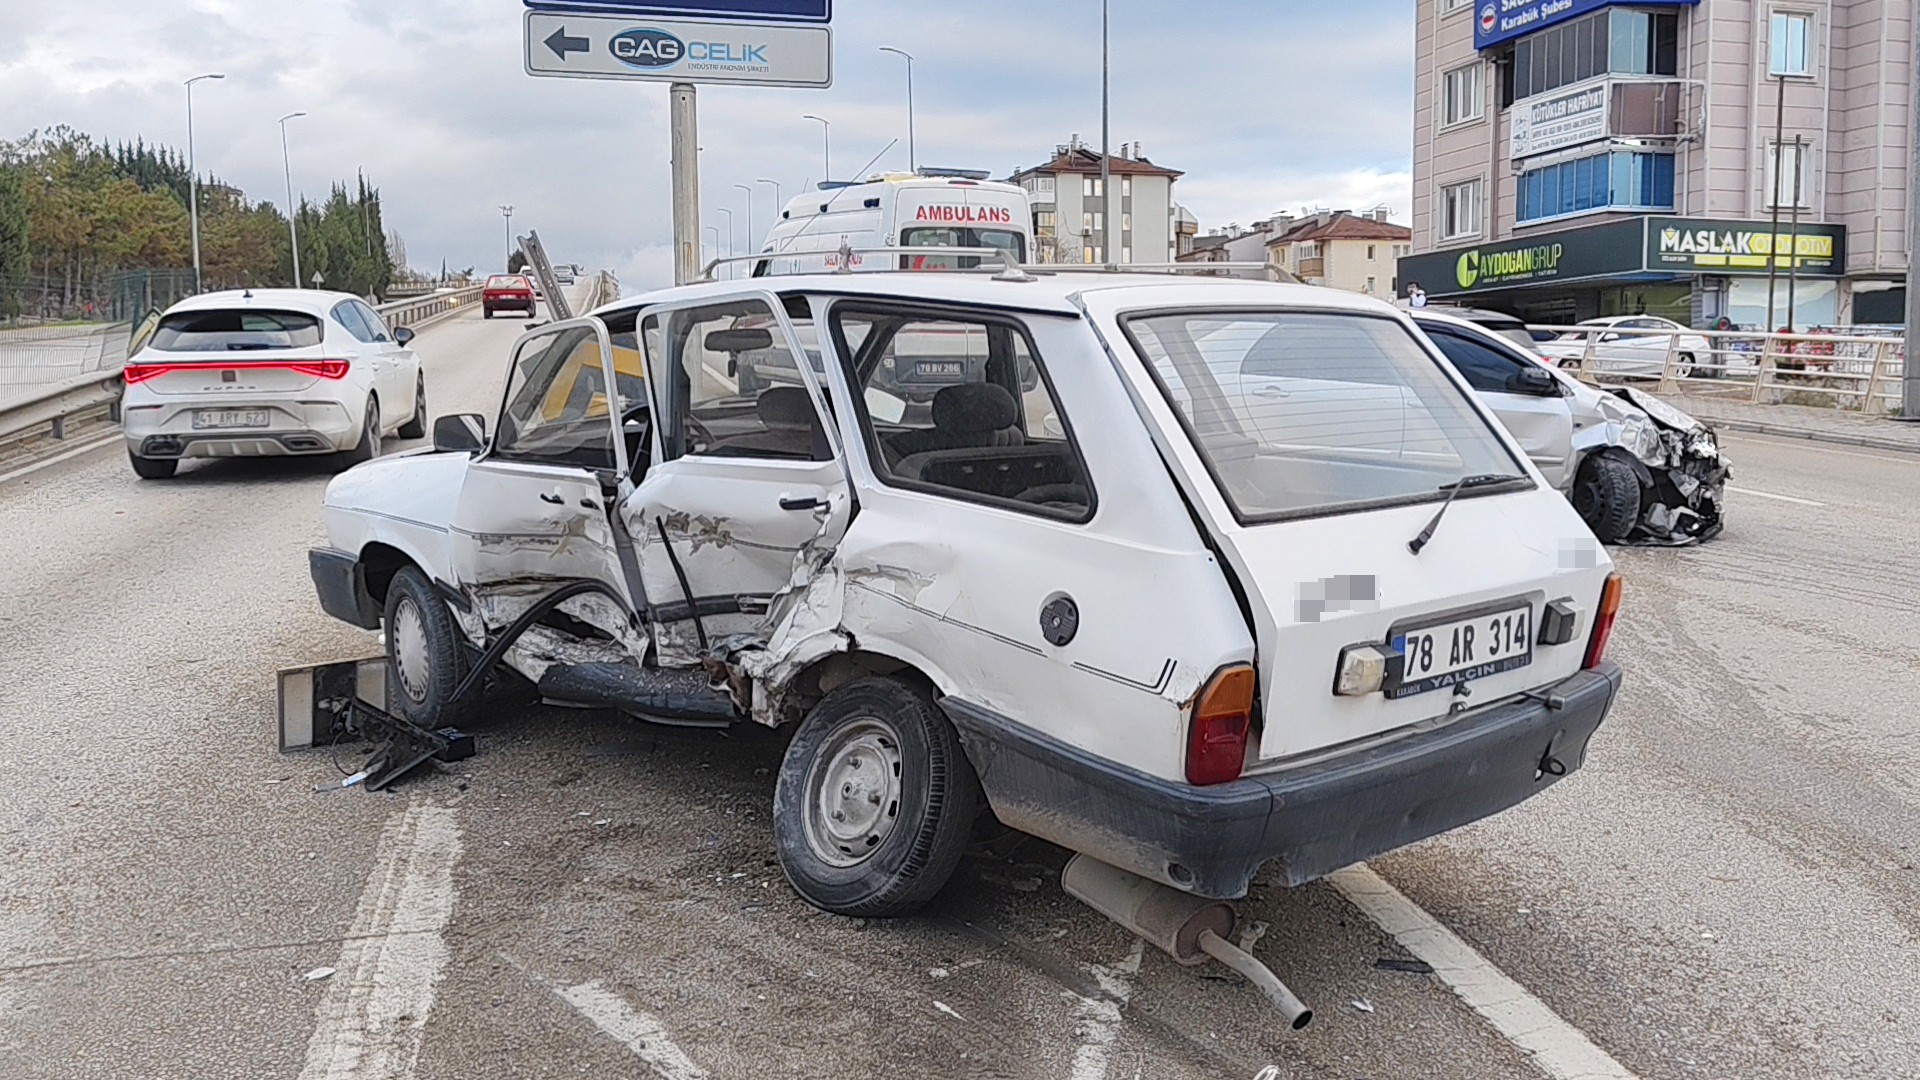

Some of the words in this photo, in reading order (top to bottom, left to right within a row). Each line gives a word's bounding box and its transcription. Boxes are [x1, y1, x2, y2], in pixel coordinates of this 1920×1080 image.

[1501, 7, 1539, 31] Karabük
[915, 205, 1011, 222] AMBULANS
[1660, 228, 1751, 253] MASLAK
[200, 413, 212, 424] 41
[219, 412, 239, 424] ARY
[1406, 633, 1433, 677] 78
[1449, 625, 1474, 666] AR
[1489, 613, 1525, 656] 314
